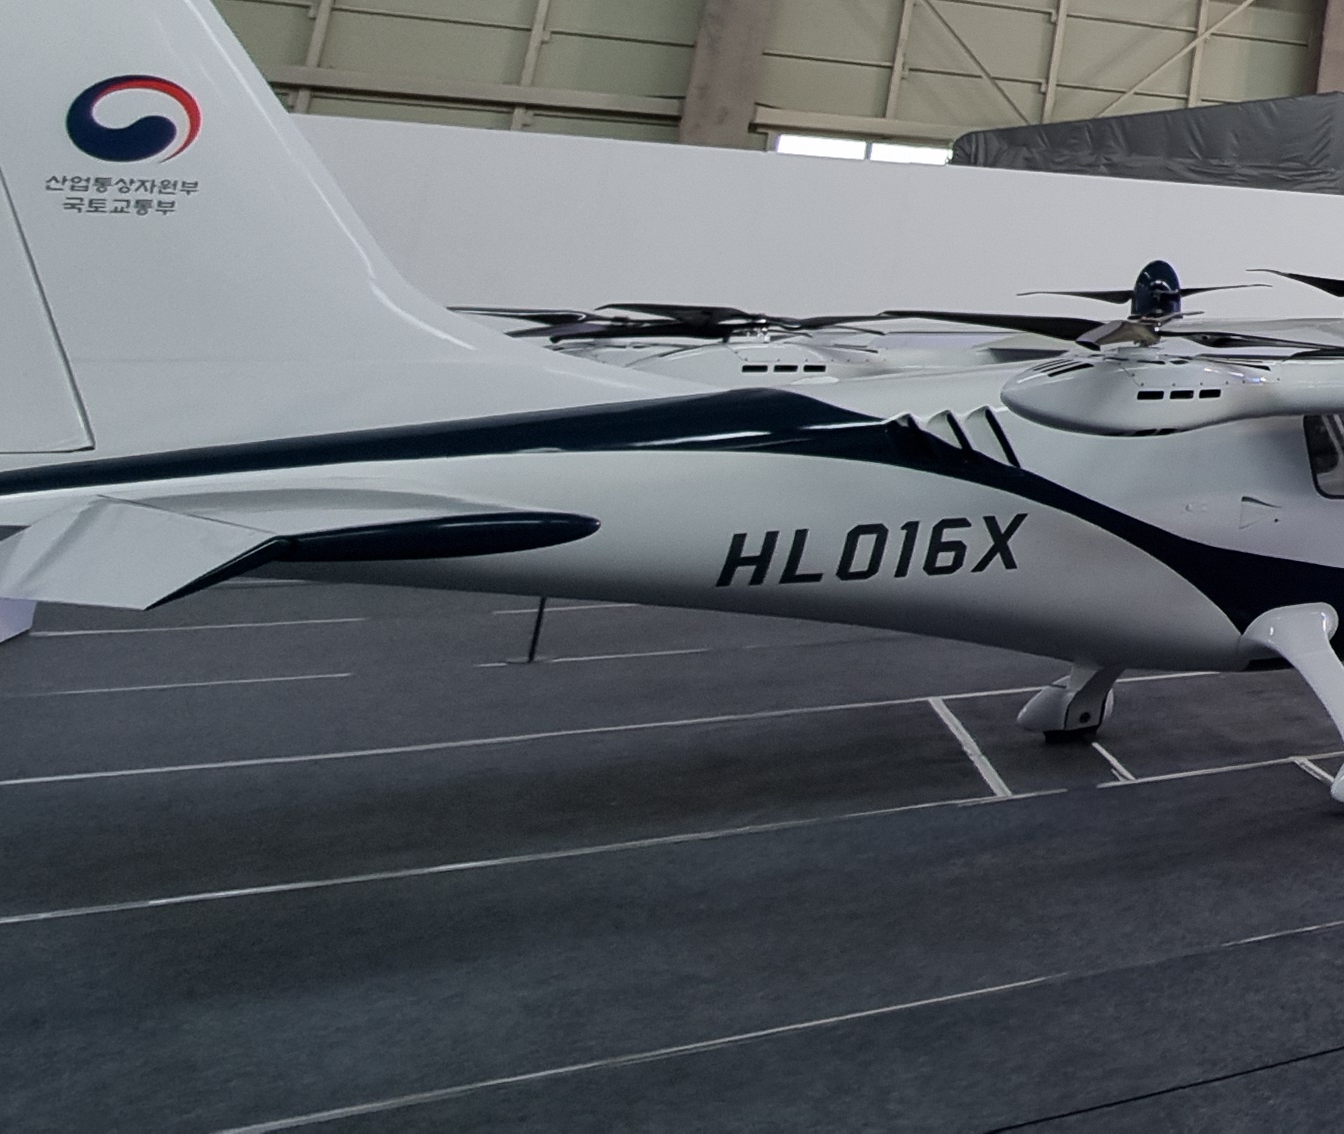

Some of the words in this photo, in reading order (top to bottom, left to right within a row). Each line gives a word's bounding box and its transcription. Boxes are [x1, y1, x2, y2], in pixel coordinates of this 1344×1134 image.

[44, 175, 199, 196] 산업통상자원부
[62, 197, 176, 215] 국토교통부
[715, 513, 1029, 587] HL016X
